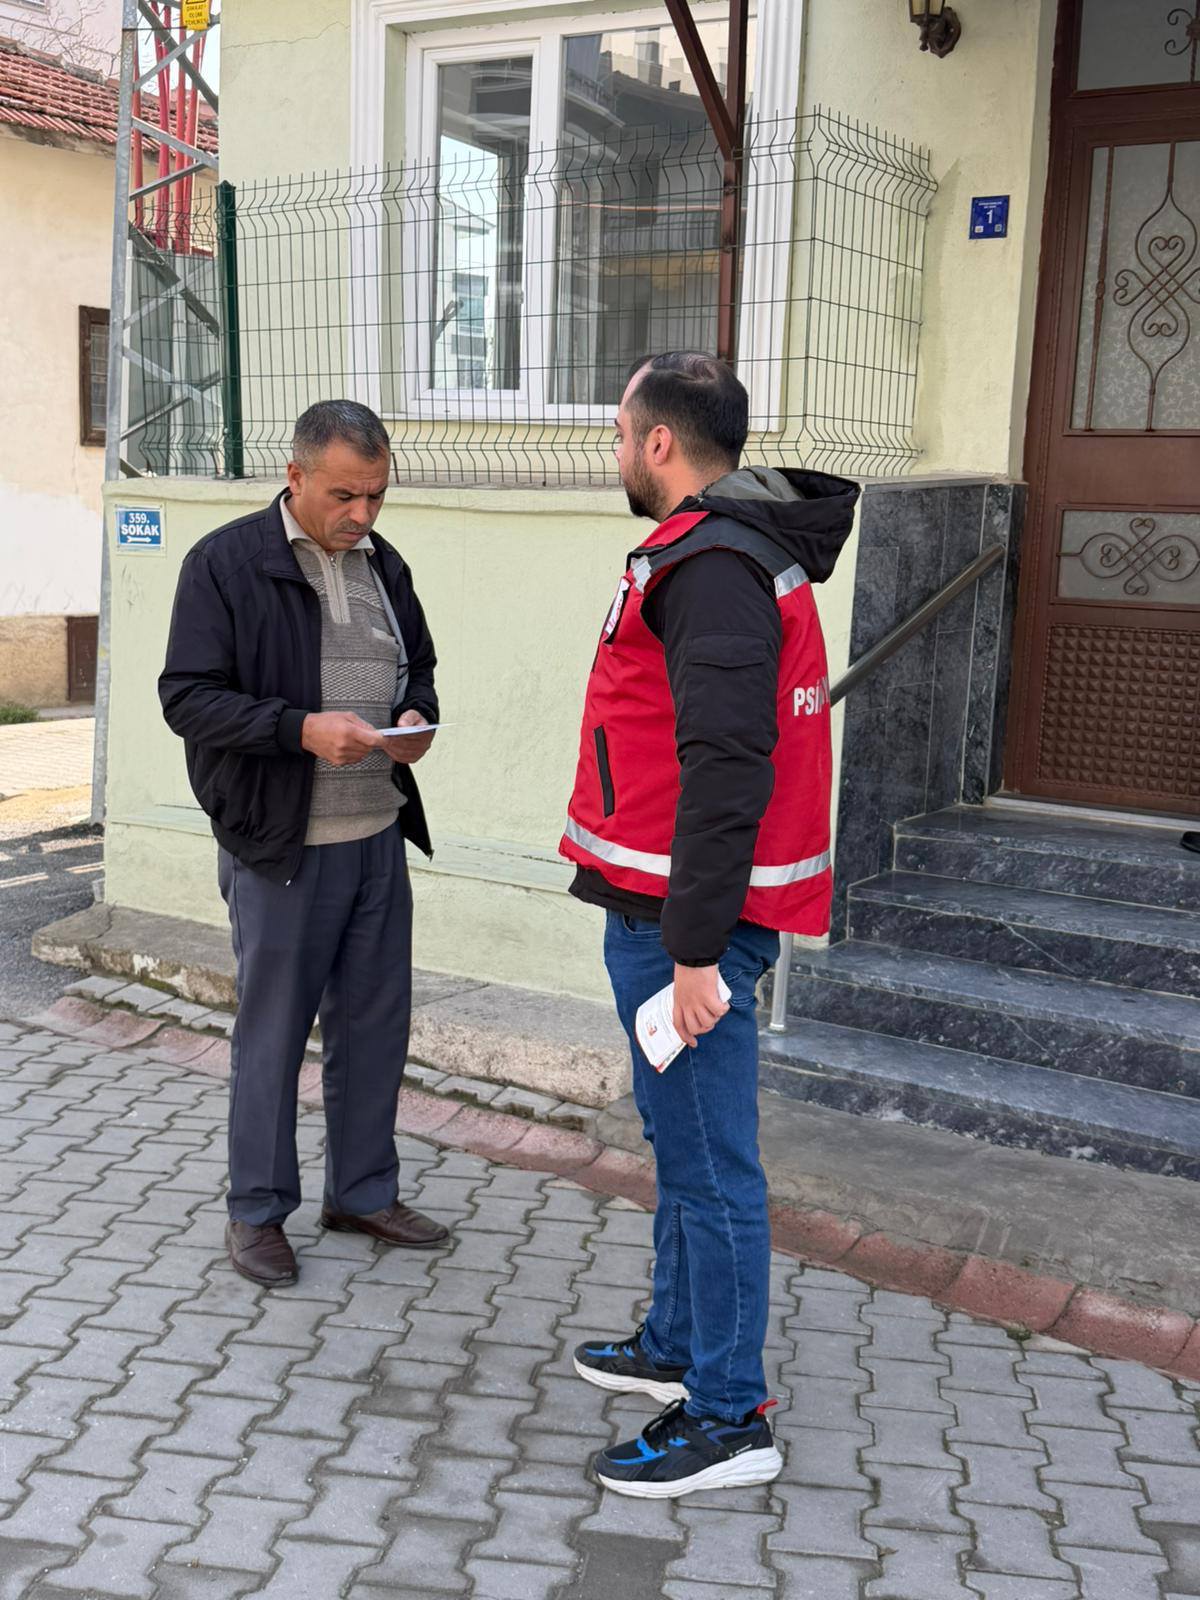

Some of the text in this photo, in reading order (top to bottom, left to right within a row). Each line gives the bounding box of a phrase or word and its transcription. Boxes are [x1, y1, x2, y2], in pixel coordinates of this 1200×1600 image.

[986, 210, 993, 224] 1
[128, 512, 150, 524] 359.
[120, 524, 160, 536] SOKAK
